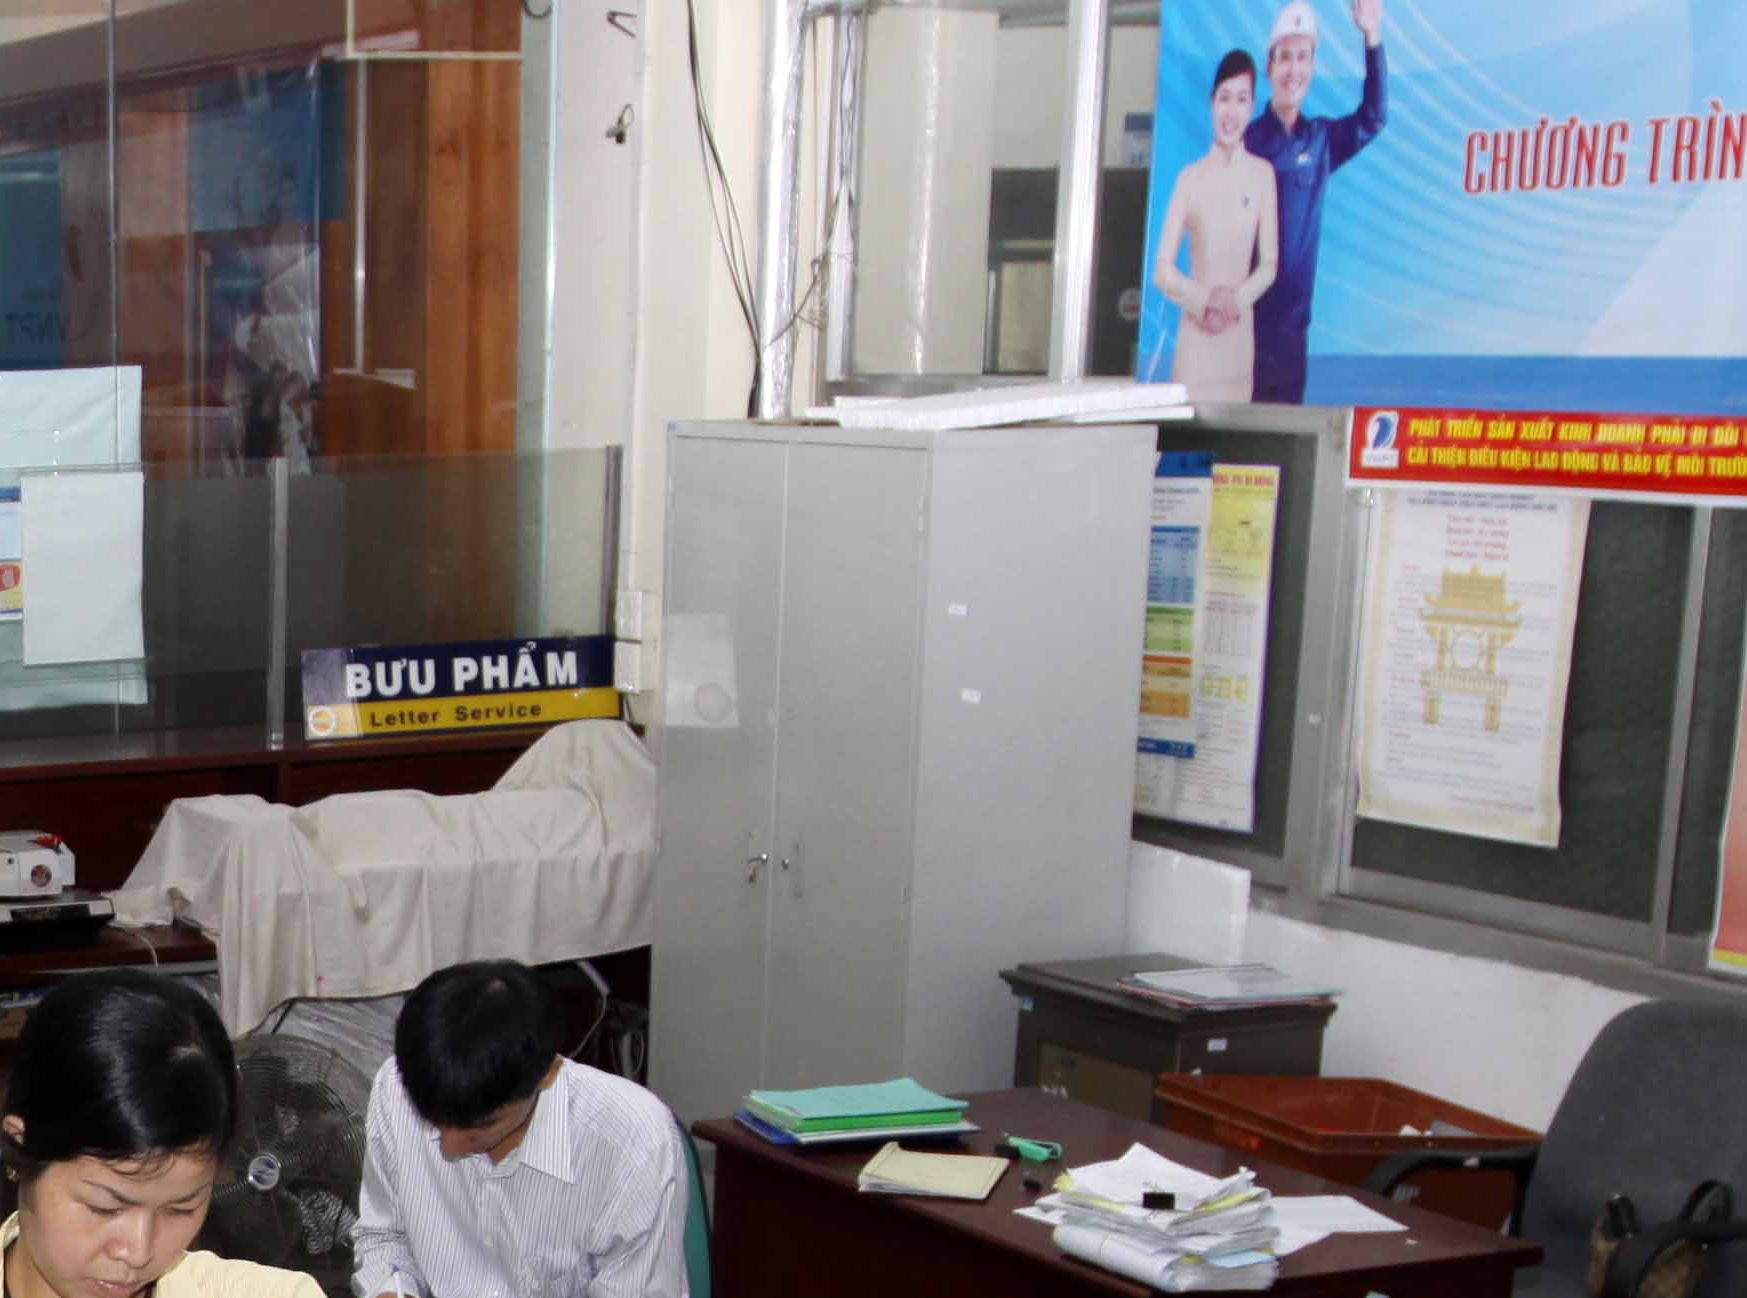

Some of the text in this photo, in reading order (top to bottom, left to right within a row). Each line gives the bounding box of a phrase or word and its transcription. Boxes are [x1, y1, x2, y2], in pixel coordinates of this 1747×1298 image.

[1464, 97, 1747, 195] CHƯƠNG TRÌN
[1520, 416, 1554, 441] XUẤT
[1533, 451, 1559, 470] LAO
[345, 640, 579, 699] BƯU PHẨM
[369, 702, 543, 728] Letter Service
